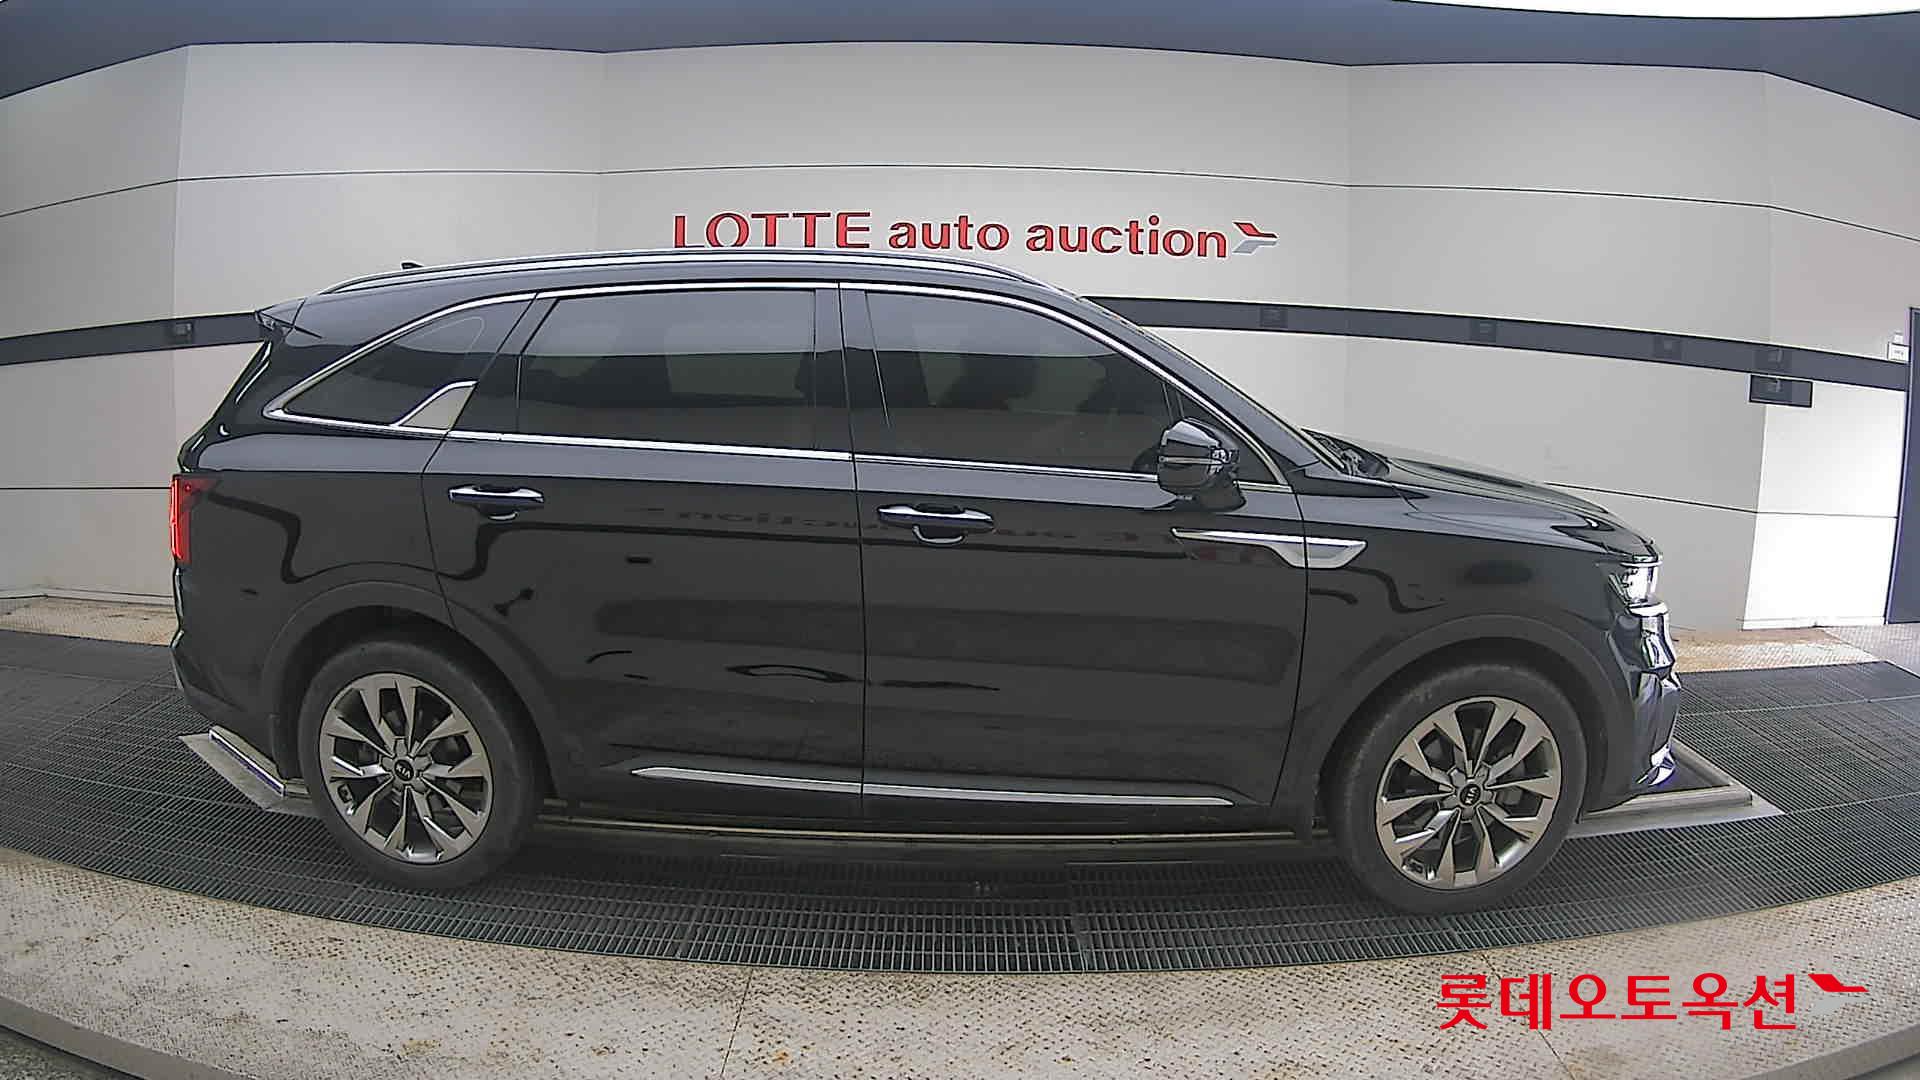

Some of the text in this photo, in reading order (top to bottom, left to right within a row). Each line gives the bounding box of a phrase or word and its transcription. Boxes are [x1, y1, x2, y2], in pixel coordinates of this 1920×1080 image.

[673, 212, 1228, 257] LOTTE auto auction
[396, 763, 411, 779] KIA
